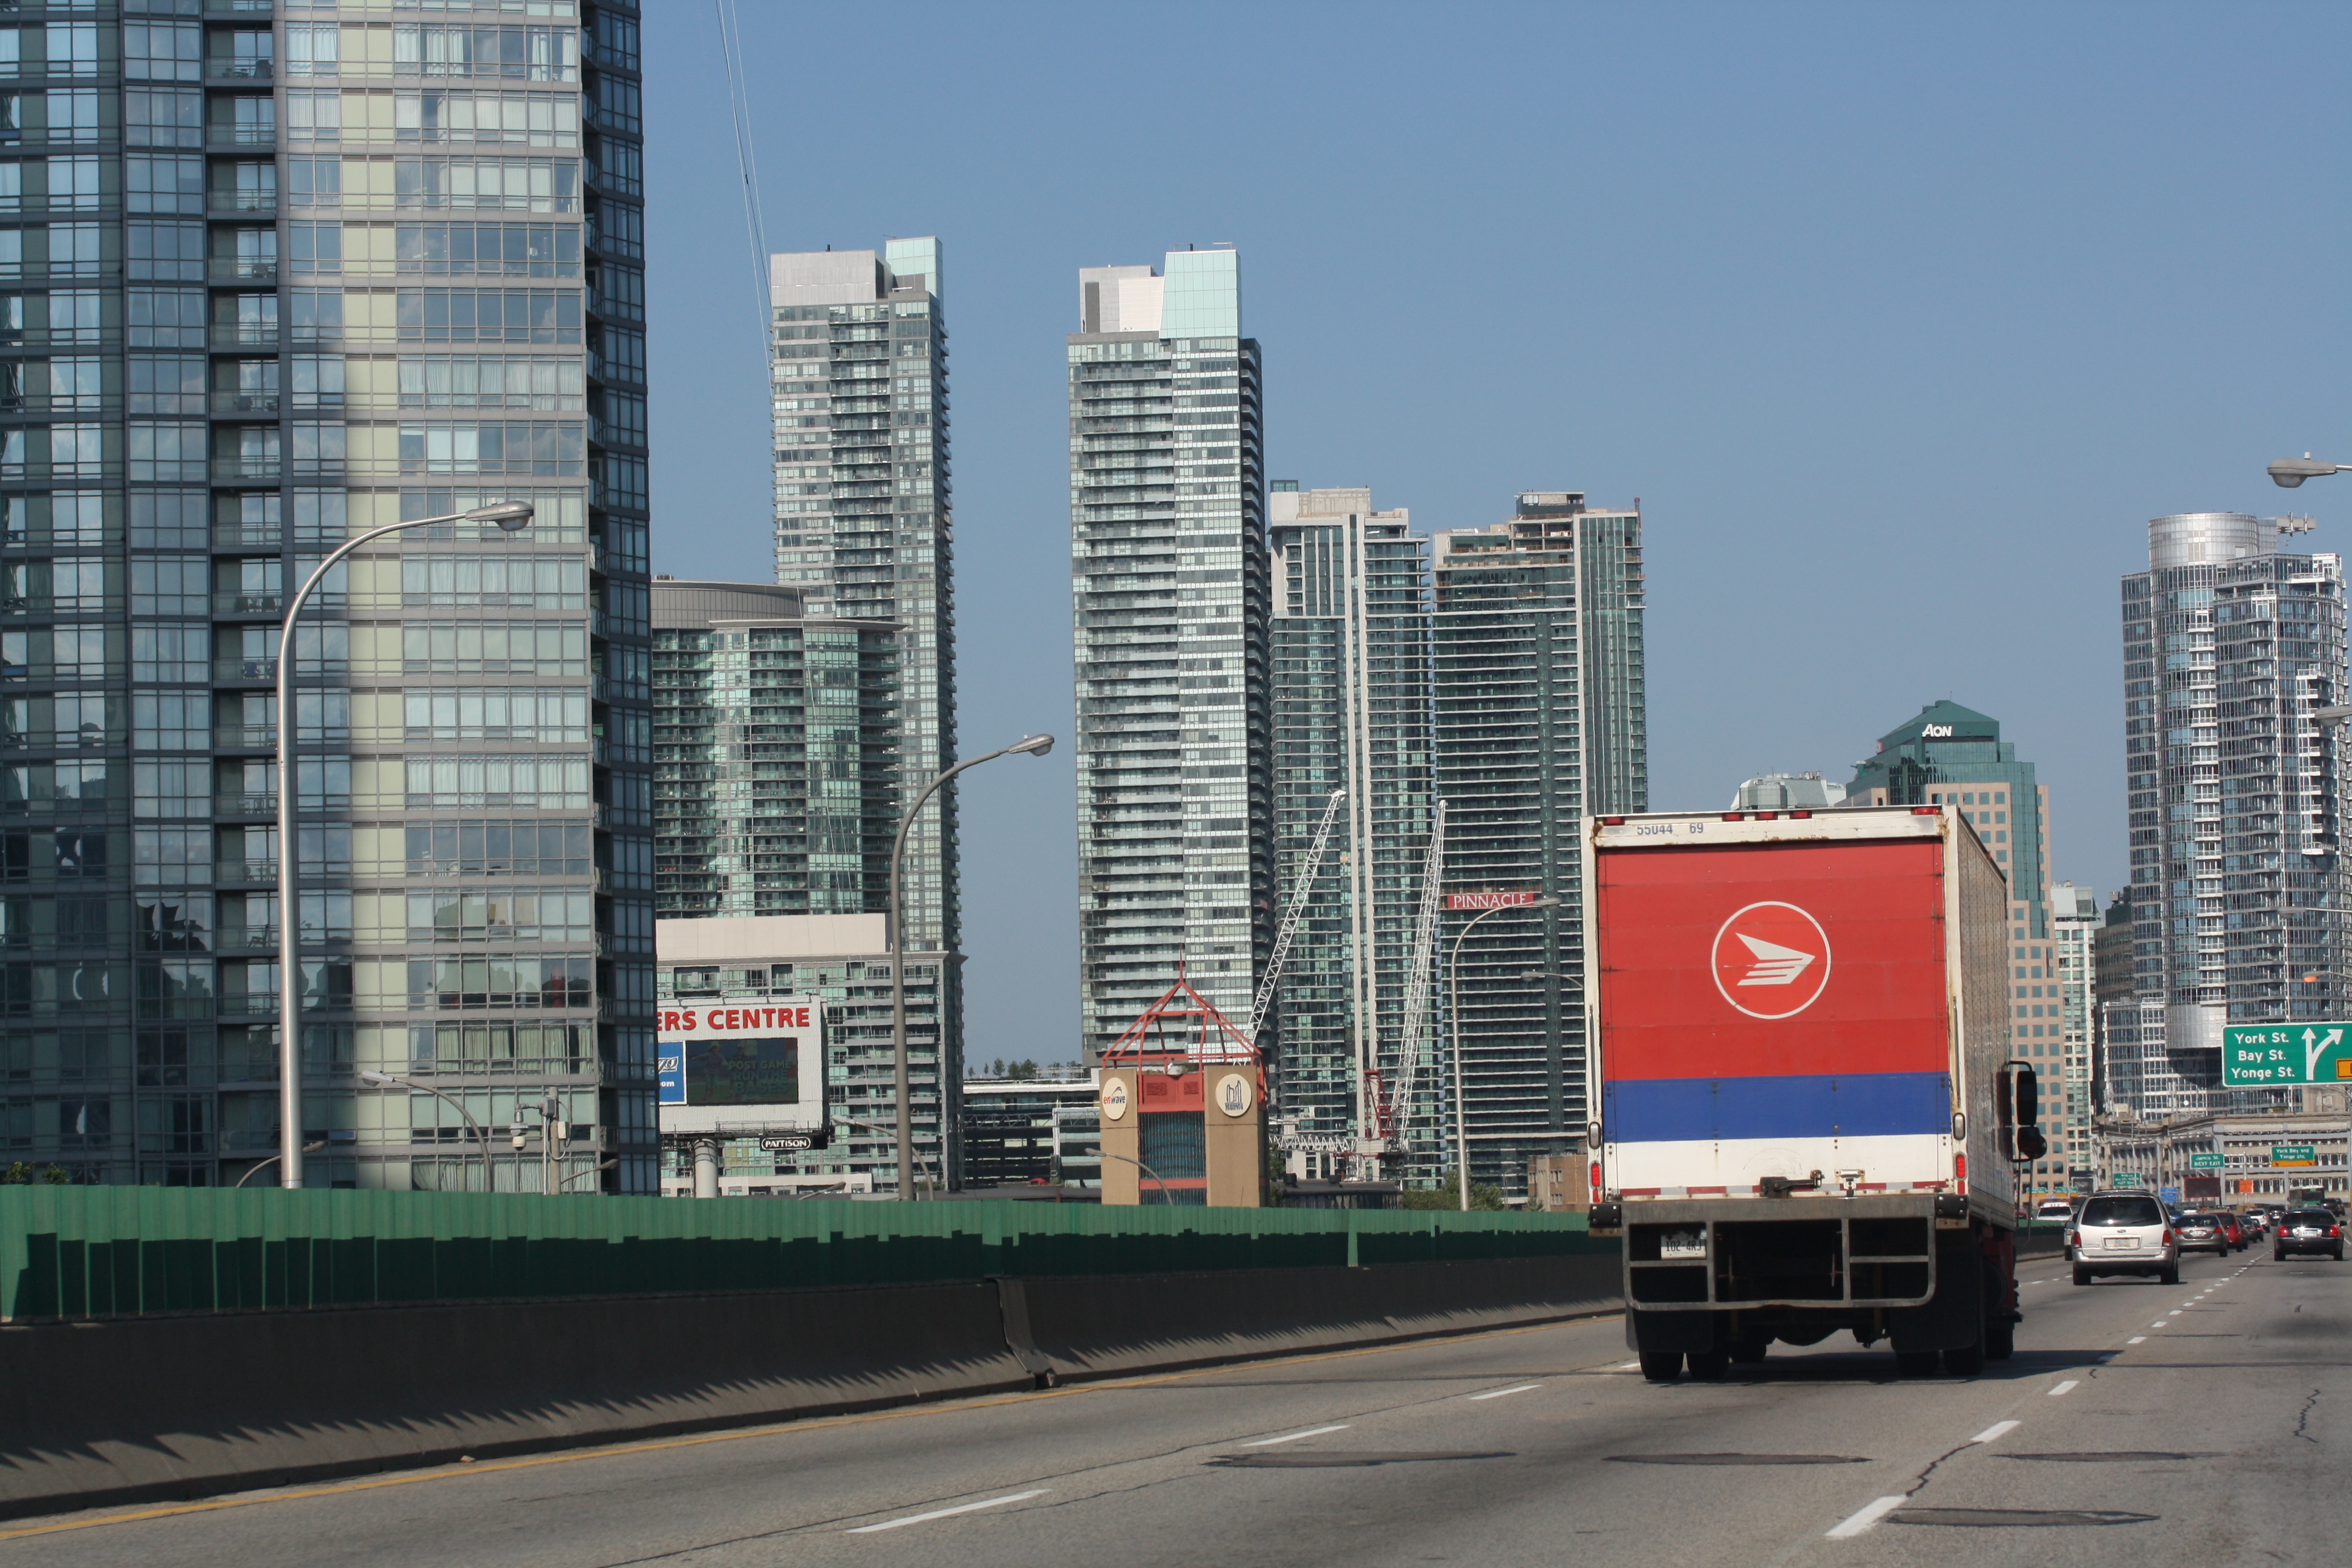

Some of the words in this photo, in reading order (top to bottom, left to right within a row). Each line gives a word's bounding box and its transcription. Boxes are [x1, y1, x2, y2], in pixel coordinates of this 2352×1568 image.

[1637, 824, 1673, 835] 55044
[1690, 822, 1704, 834] 69
[1454, 893, 1526, 908] PINNACLE
[708, 1007, 810, 1030] CENTRE
[2234, 1033, 2266, 1044] York
[2272, 1032, 2289, 1043] St.
[2238, 1050, 2263, 1063] Bay
[2269, 1049, 2287, 1061] St.
[728, 1060, 757, 1070] POST
[760, 1060, 792, 1070] GAME
[733, 1070, 760, 1081] RUN
[763, 1069, 788, 1080] THE
[2231, 1068, 2272, 1081] Yonge
[2278, 1067, 2295, 1077] St.
[734, 1080, 789, 1094] BASES
[1103, 1096, 1126, 1105] enwave
